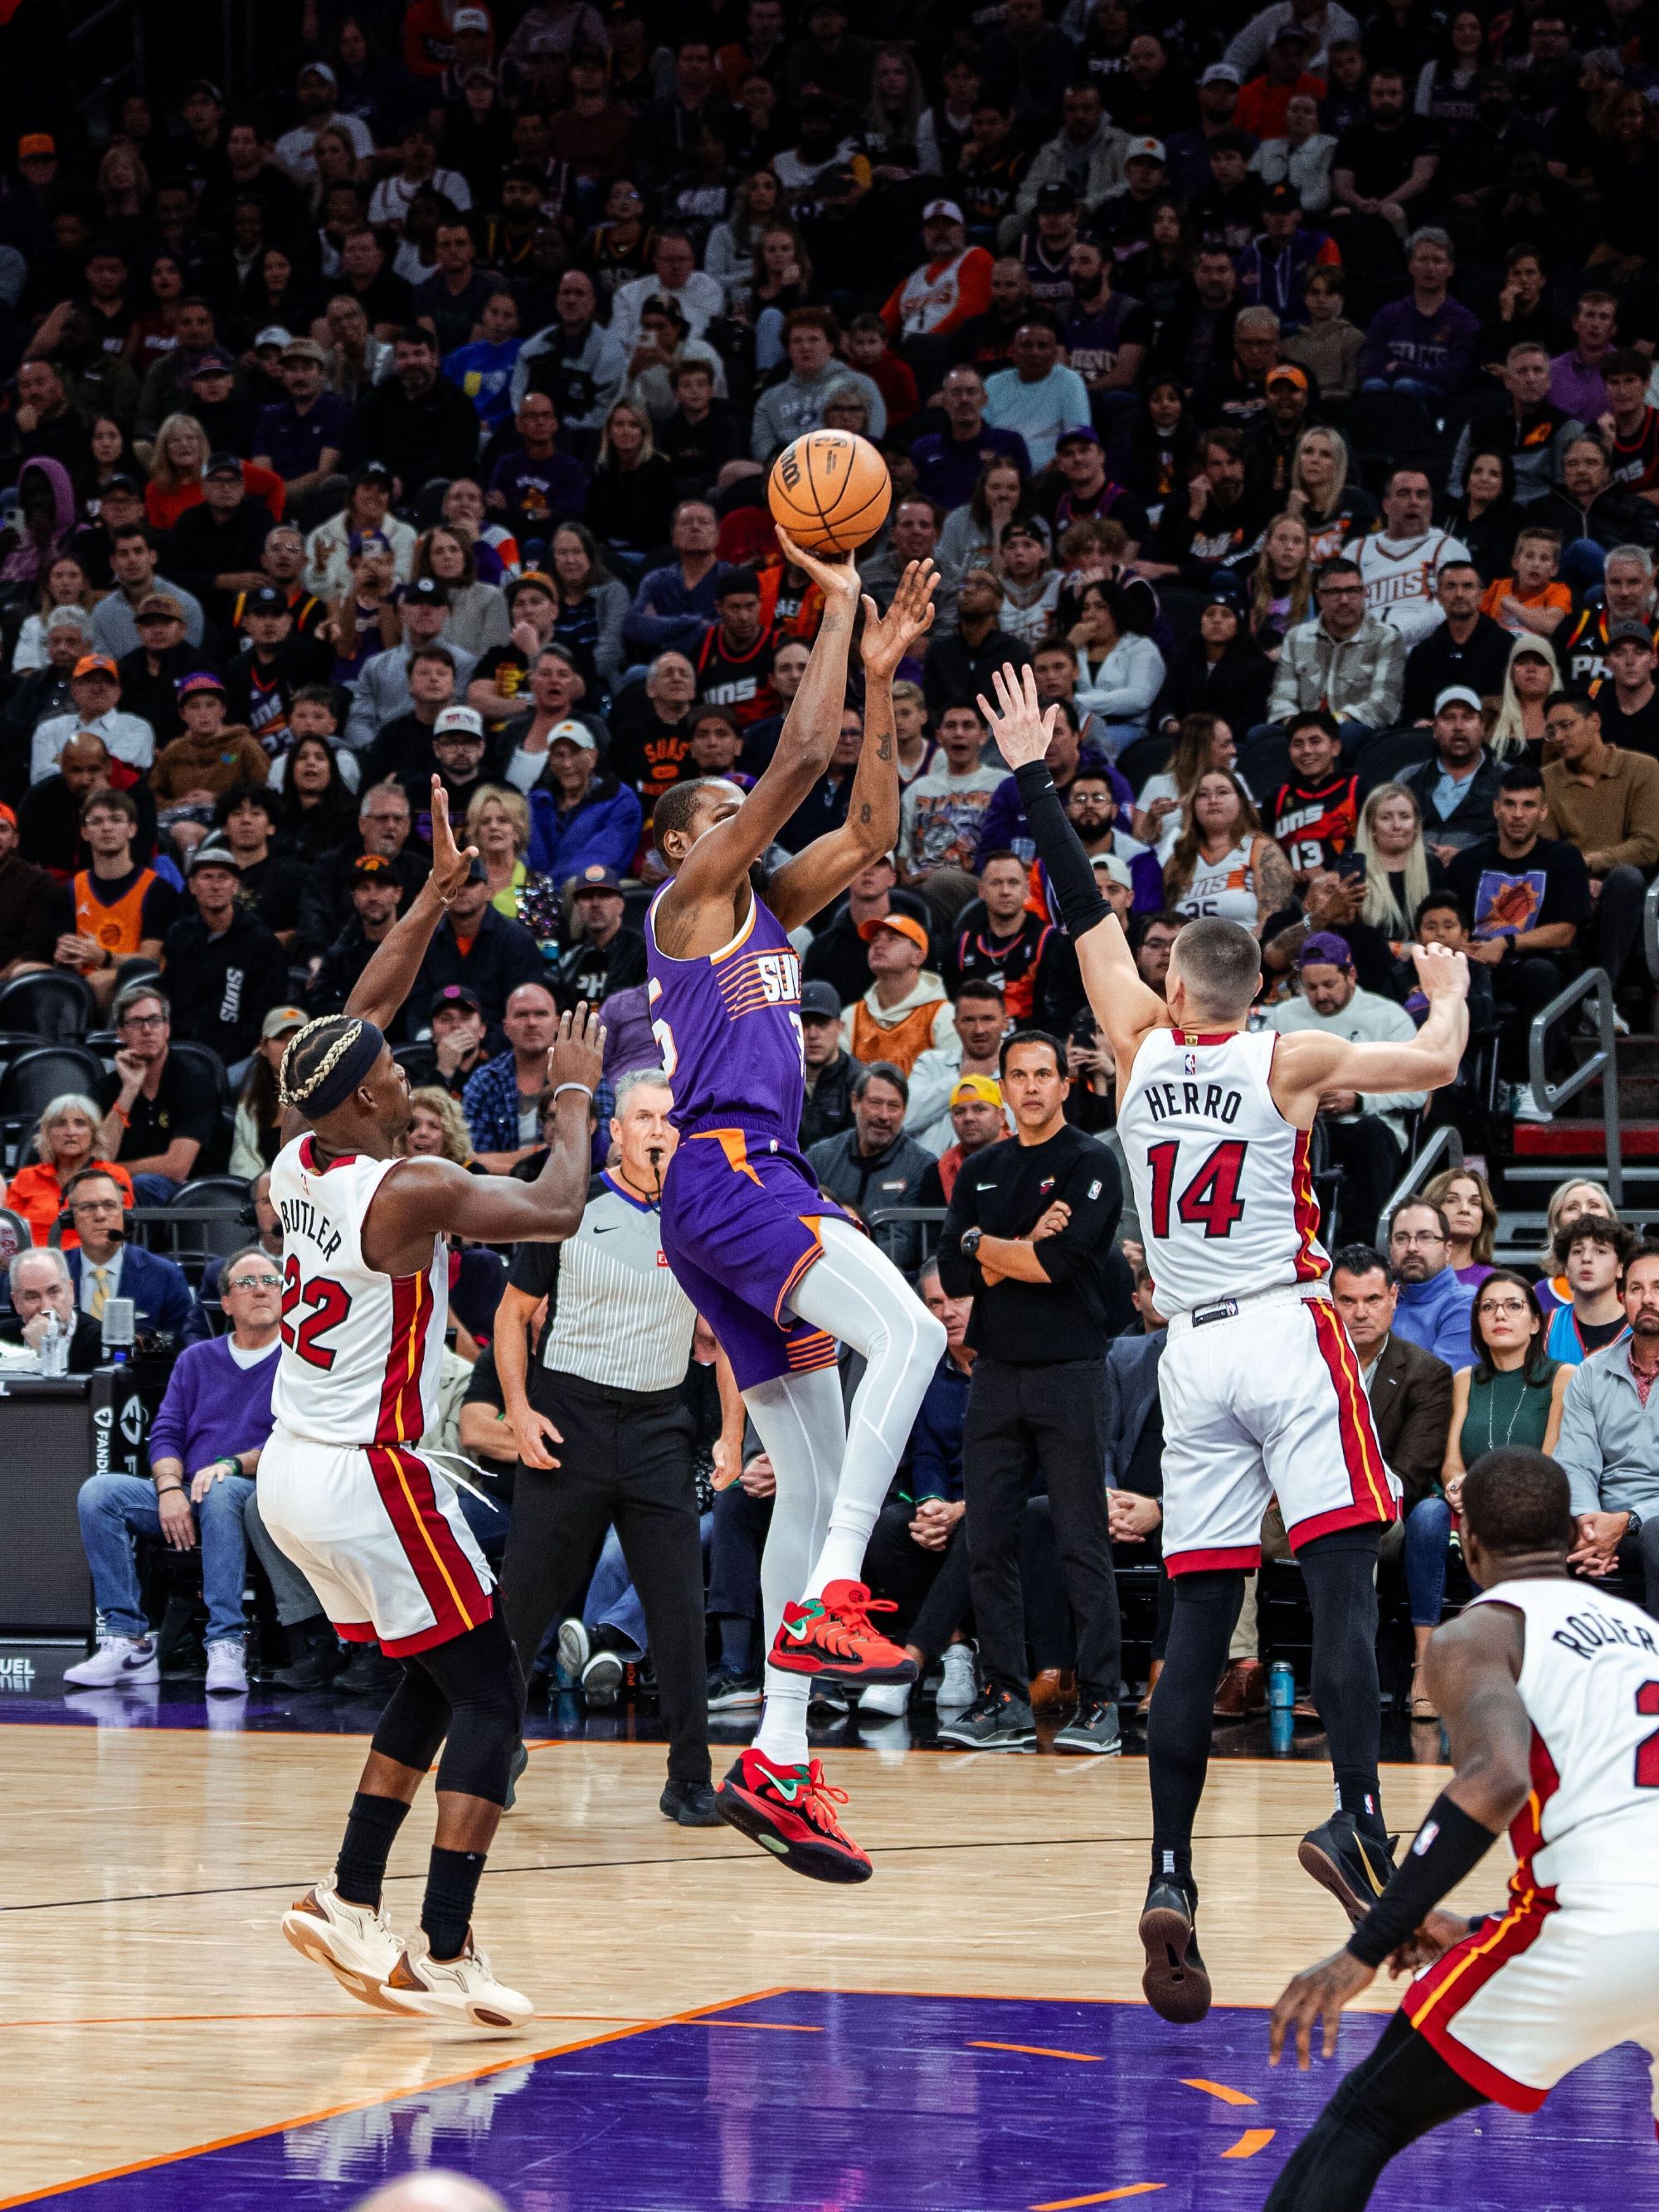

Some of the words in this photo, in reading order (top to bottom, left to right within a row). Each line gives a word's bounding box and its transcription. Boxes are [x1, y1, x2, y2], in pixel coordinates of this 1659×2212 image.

[1365, 570, 1423, 608] UNS
[1290, 840, 1325, 871] 13
[219, 966, 246, 1023] SUNS
[1145, 1082, 1243, 1125] HERRO
[1146, 1140, 1249, 1239] 14
[280, 1198, 342, 1263] BUTLER
[280, 1252, 353, 1372] 22
[1549, 1612, 1659, 1660] ROZIER
